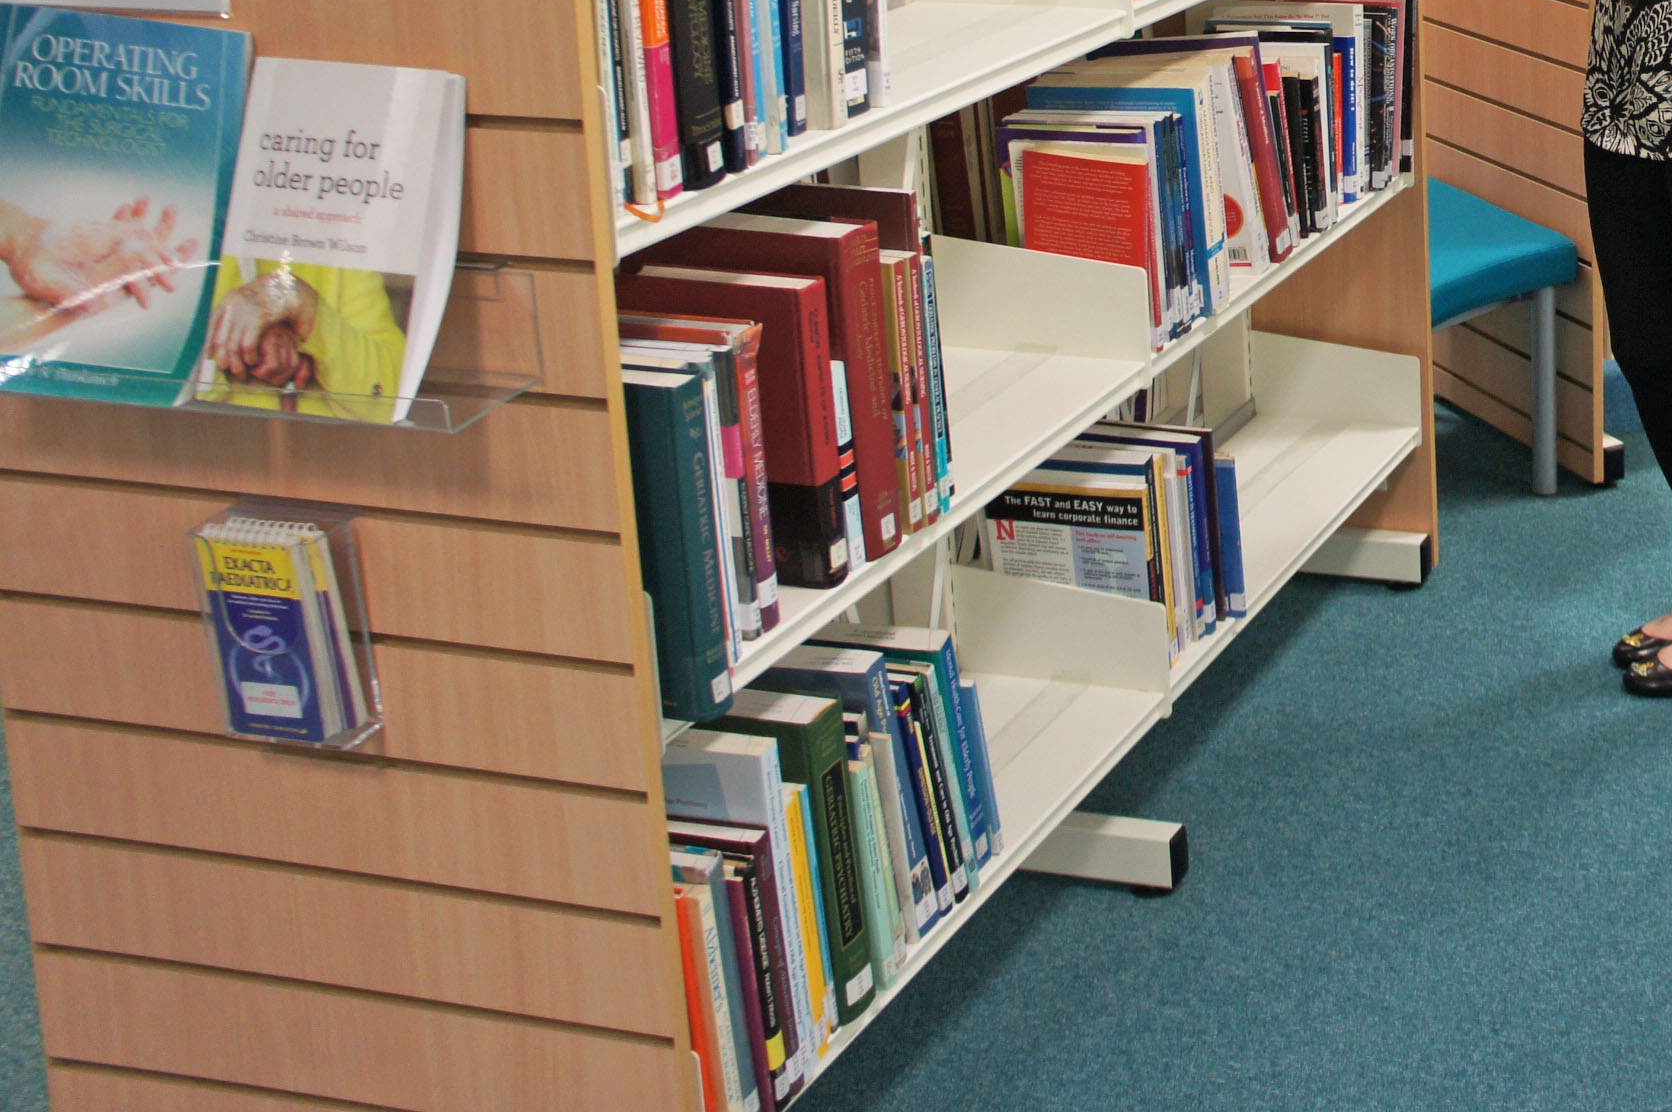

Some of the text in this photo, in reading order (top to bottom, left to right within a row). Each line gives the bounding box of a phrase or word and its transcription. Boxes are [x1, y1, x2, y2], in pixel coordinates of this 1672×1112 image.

[790, 0, 801, 37] Nursing
[31, 34, 200, 81] OPERATING
[697, 0, 714, 85] MEDICINE
[14, 60, 212, 112] ROOM SKILLS
[259, 128, 382, 163] caring for
[253, 160, 405, 205] older people
[747, 387, 768, 521] ELDERLY MEDICINE
[1004, 495, 1138, 515] The FAST and EASY way to
[1033, 508, 1139, 526] learn corporate finance
[693, 451, 721, 635] GERIATRIC MEDICINE
[223, 556, 277, 576] EXACTA
[946, 648, 958, 677] Mental
[949, 679, 962, 706] Health
[954, 706, 966, 728] Care
[960, 739, 973, 773] Elderly
[965, 774, 977, 800] People
[824, 775, 853, 938] GERIATRIC PSYCHIATRY
[702, 926, 726, 1014] Alzheimer's
